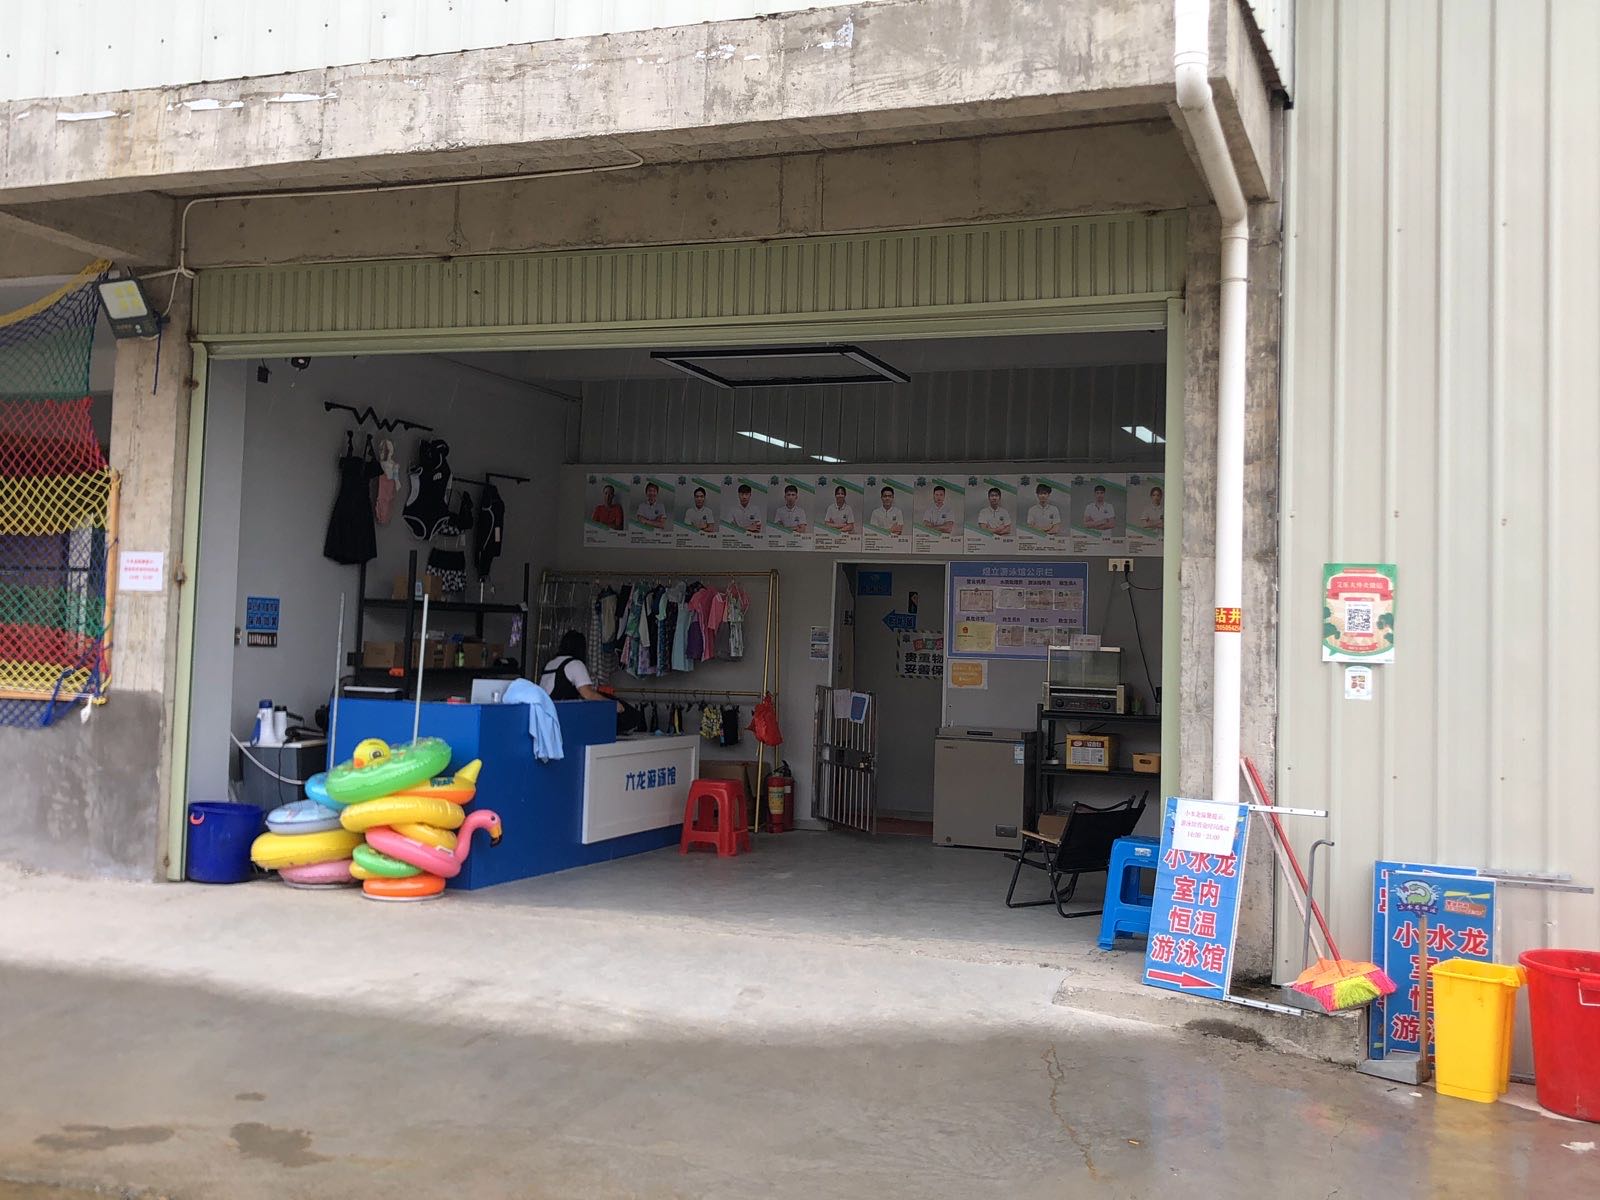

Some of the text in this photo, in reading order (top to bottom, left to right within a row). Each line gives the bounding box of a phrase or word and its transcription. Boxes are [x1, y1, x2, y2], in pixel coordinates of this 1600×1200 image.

[904, 652, 943, 663] 贵重物
[904, 664, 943, 675] 妥善保
[1163, 848, 1237, 877] 小水龙
[1171, 875, 1221, 907] 室内
[1168, 906, 1216, 938] 恒温
[1393, 921, 1488, 955] 小水龙
[1150, 934, 1227, 973] 游泳馆
